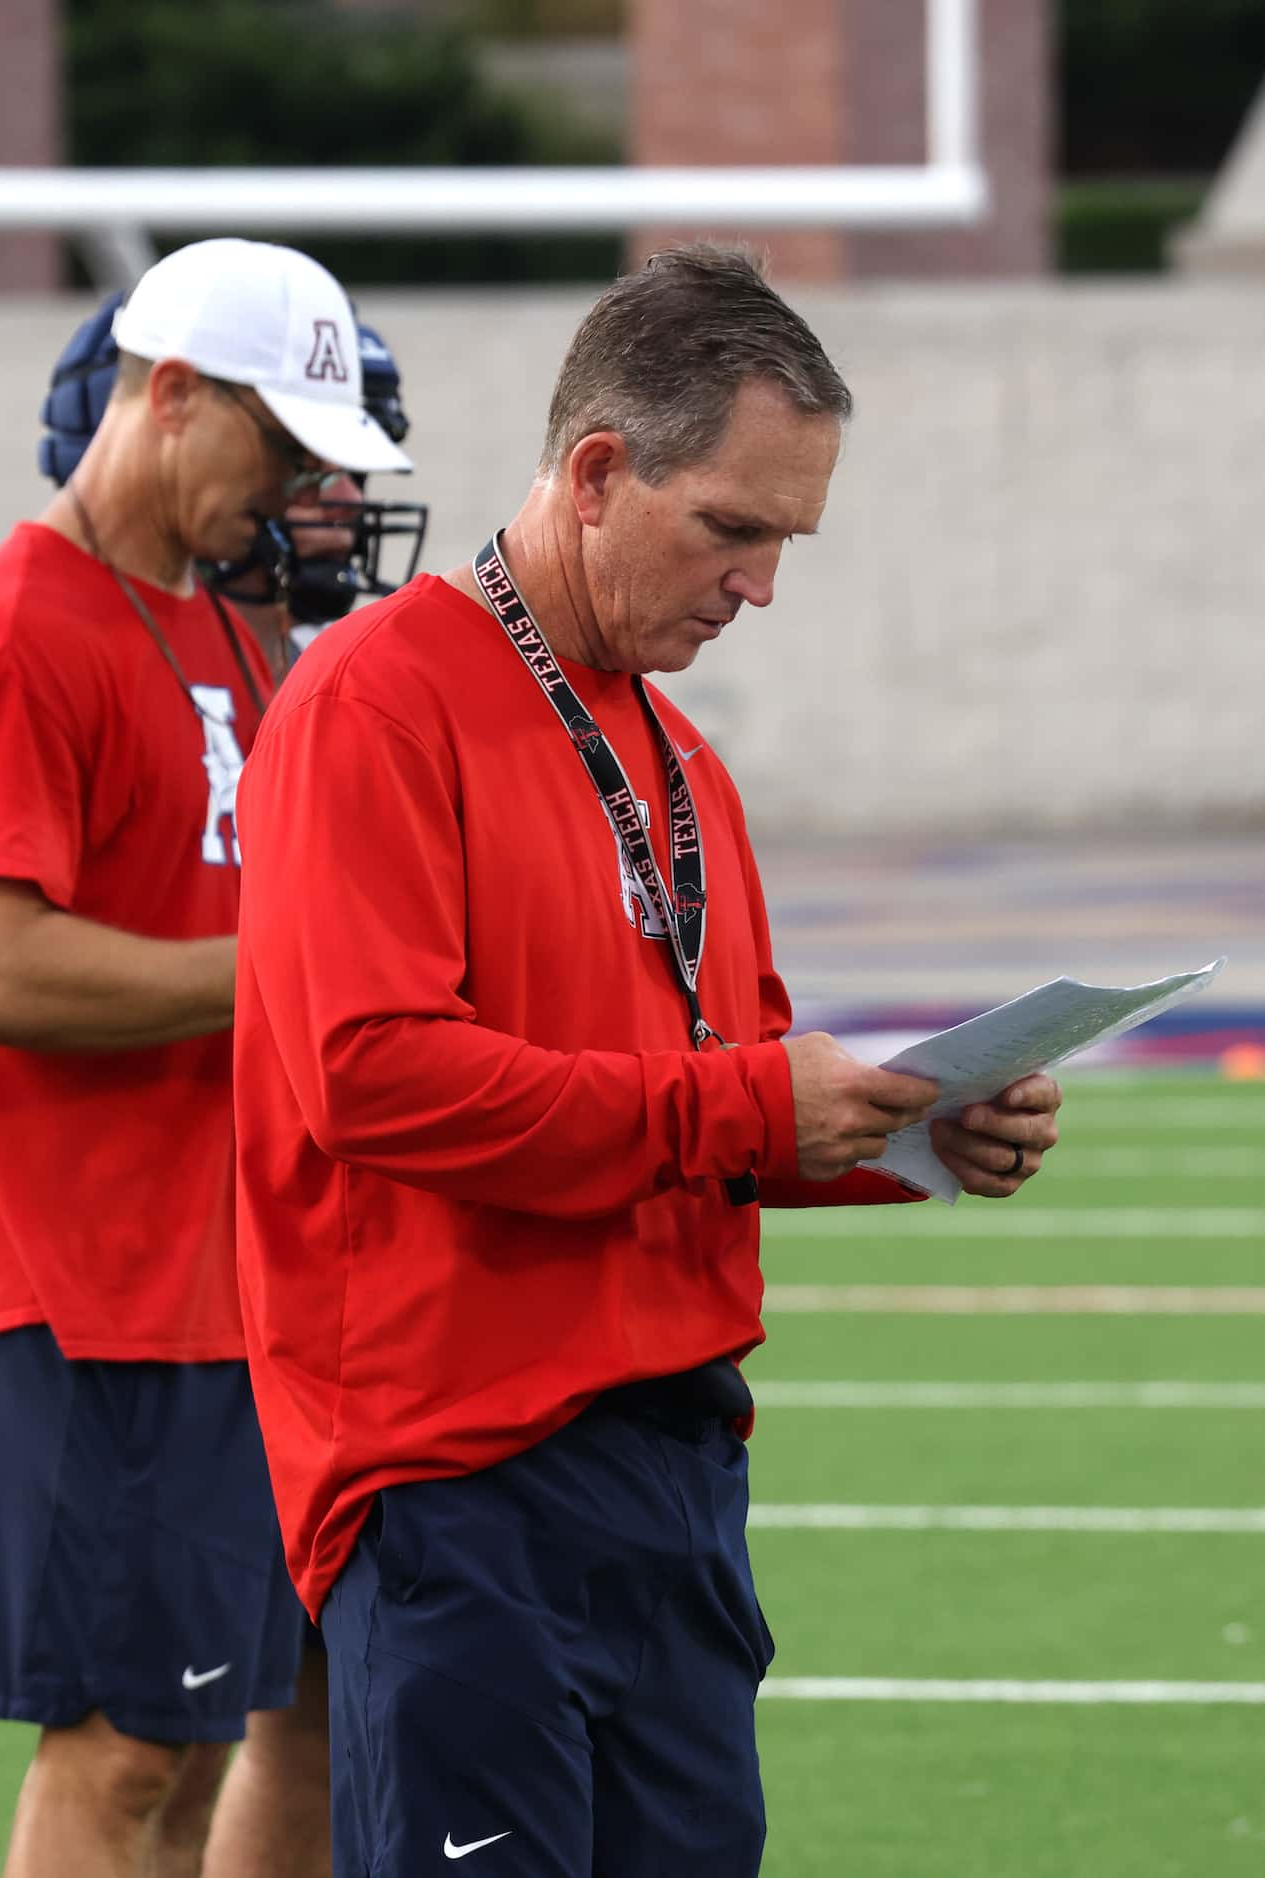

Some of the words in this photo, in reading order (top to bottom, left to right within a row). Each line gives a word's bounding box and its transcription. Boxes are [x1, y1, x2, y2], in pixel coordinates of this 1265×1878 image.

[305, 320, 347, 382] A
[477, 555, 518, 616] TECH
[507, 616, 563, 692] TEXAS
[605, 787, 645, 853] TECH
[672, 784, 698, 859] TEXAS
